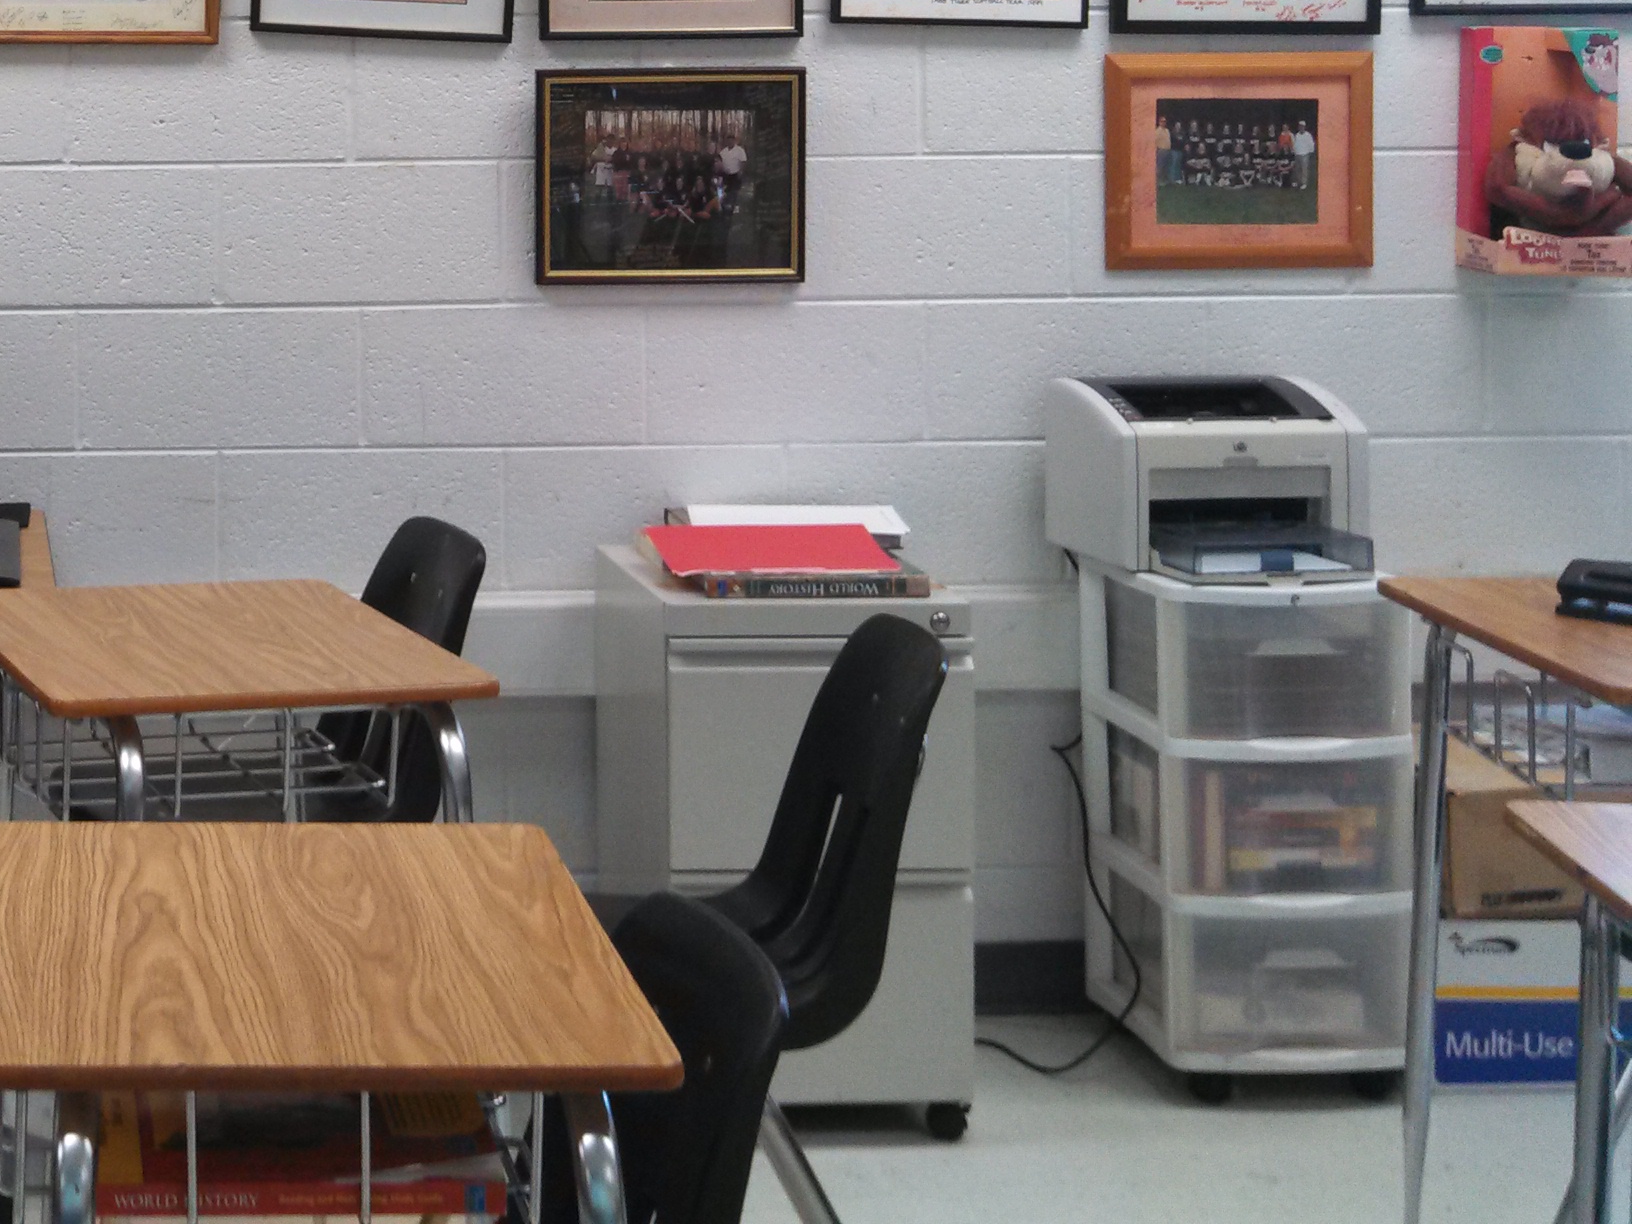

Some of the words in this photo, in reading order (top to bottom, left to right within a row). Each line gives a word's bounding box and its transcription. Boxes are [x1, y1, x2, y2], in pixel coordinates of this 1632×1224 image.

[770, 584, 825, 597] HISTORY
[828, 584, 879, 596] WORLD
[1444, 1028, 1575, 1059] Multi-Use
[114, 1193, 178, 1208] WORLD
